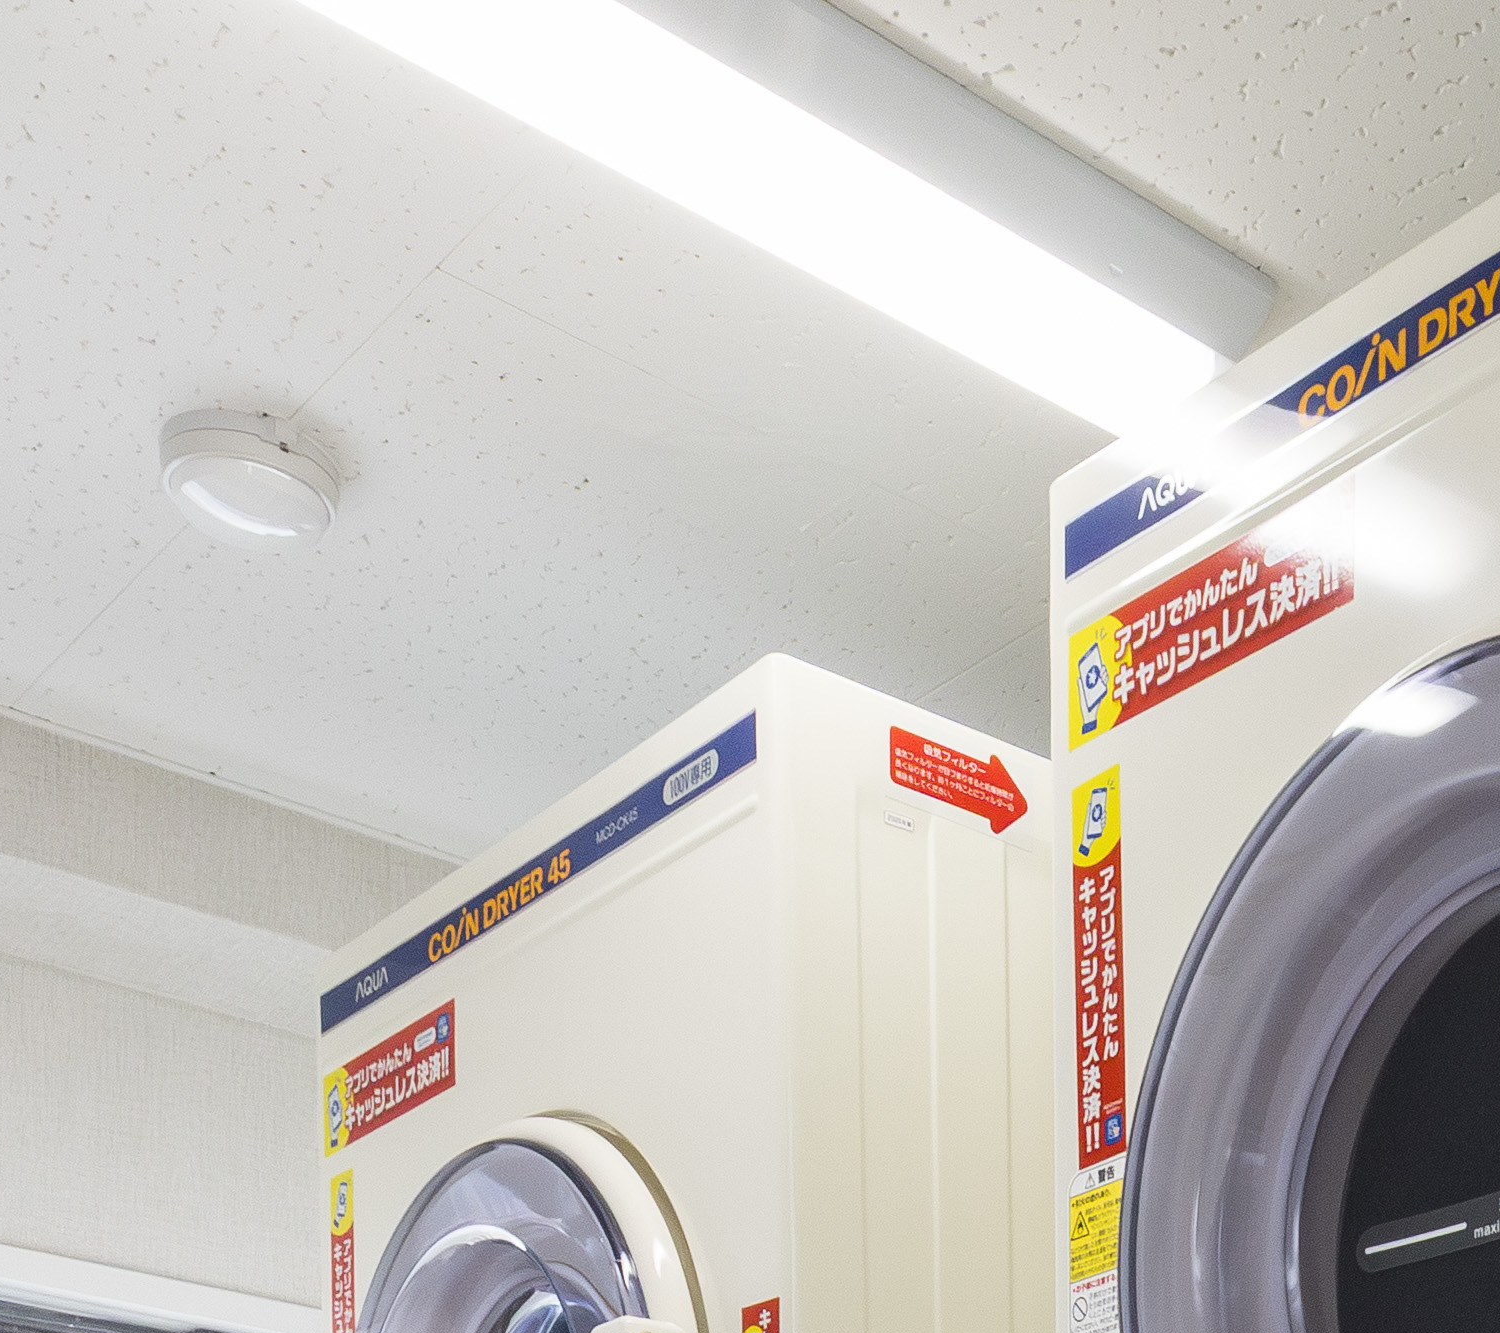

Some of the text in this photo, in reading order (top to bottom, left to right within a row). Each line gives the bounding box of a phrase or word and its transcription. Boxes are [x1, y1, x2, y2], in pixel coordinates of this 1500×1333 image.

[1299, 328, 1408, 430] COIN
[1114, 557, 1258, 660] アプリでかんたん
[669, 756, 713, 799] 100V専用
[595, 806, 639, 846] MCD-CK45
[428, 849, 571, 963] COIN DRYER 45
[355, 966, 389, 1002] AQUA
[1098, 865, 1121, 1060] アプリでかんたん
[1077, 877, 1102, 1154] キャッシュレス決済!!
[345, 1043, 412, 1098] アプリでかんたん
[345, 1046, 450, 1131] キャッシュレス決済!!
